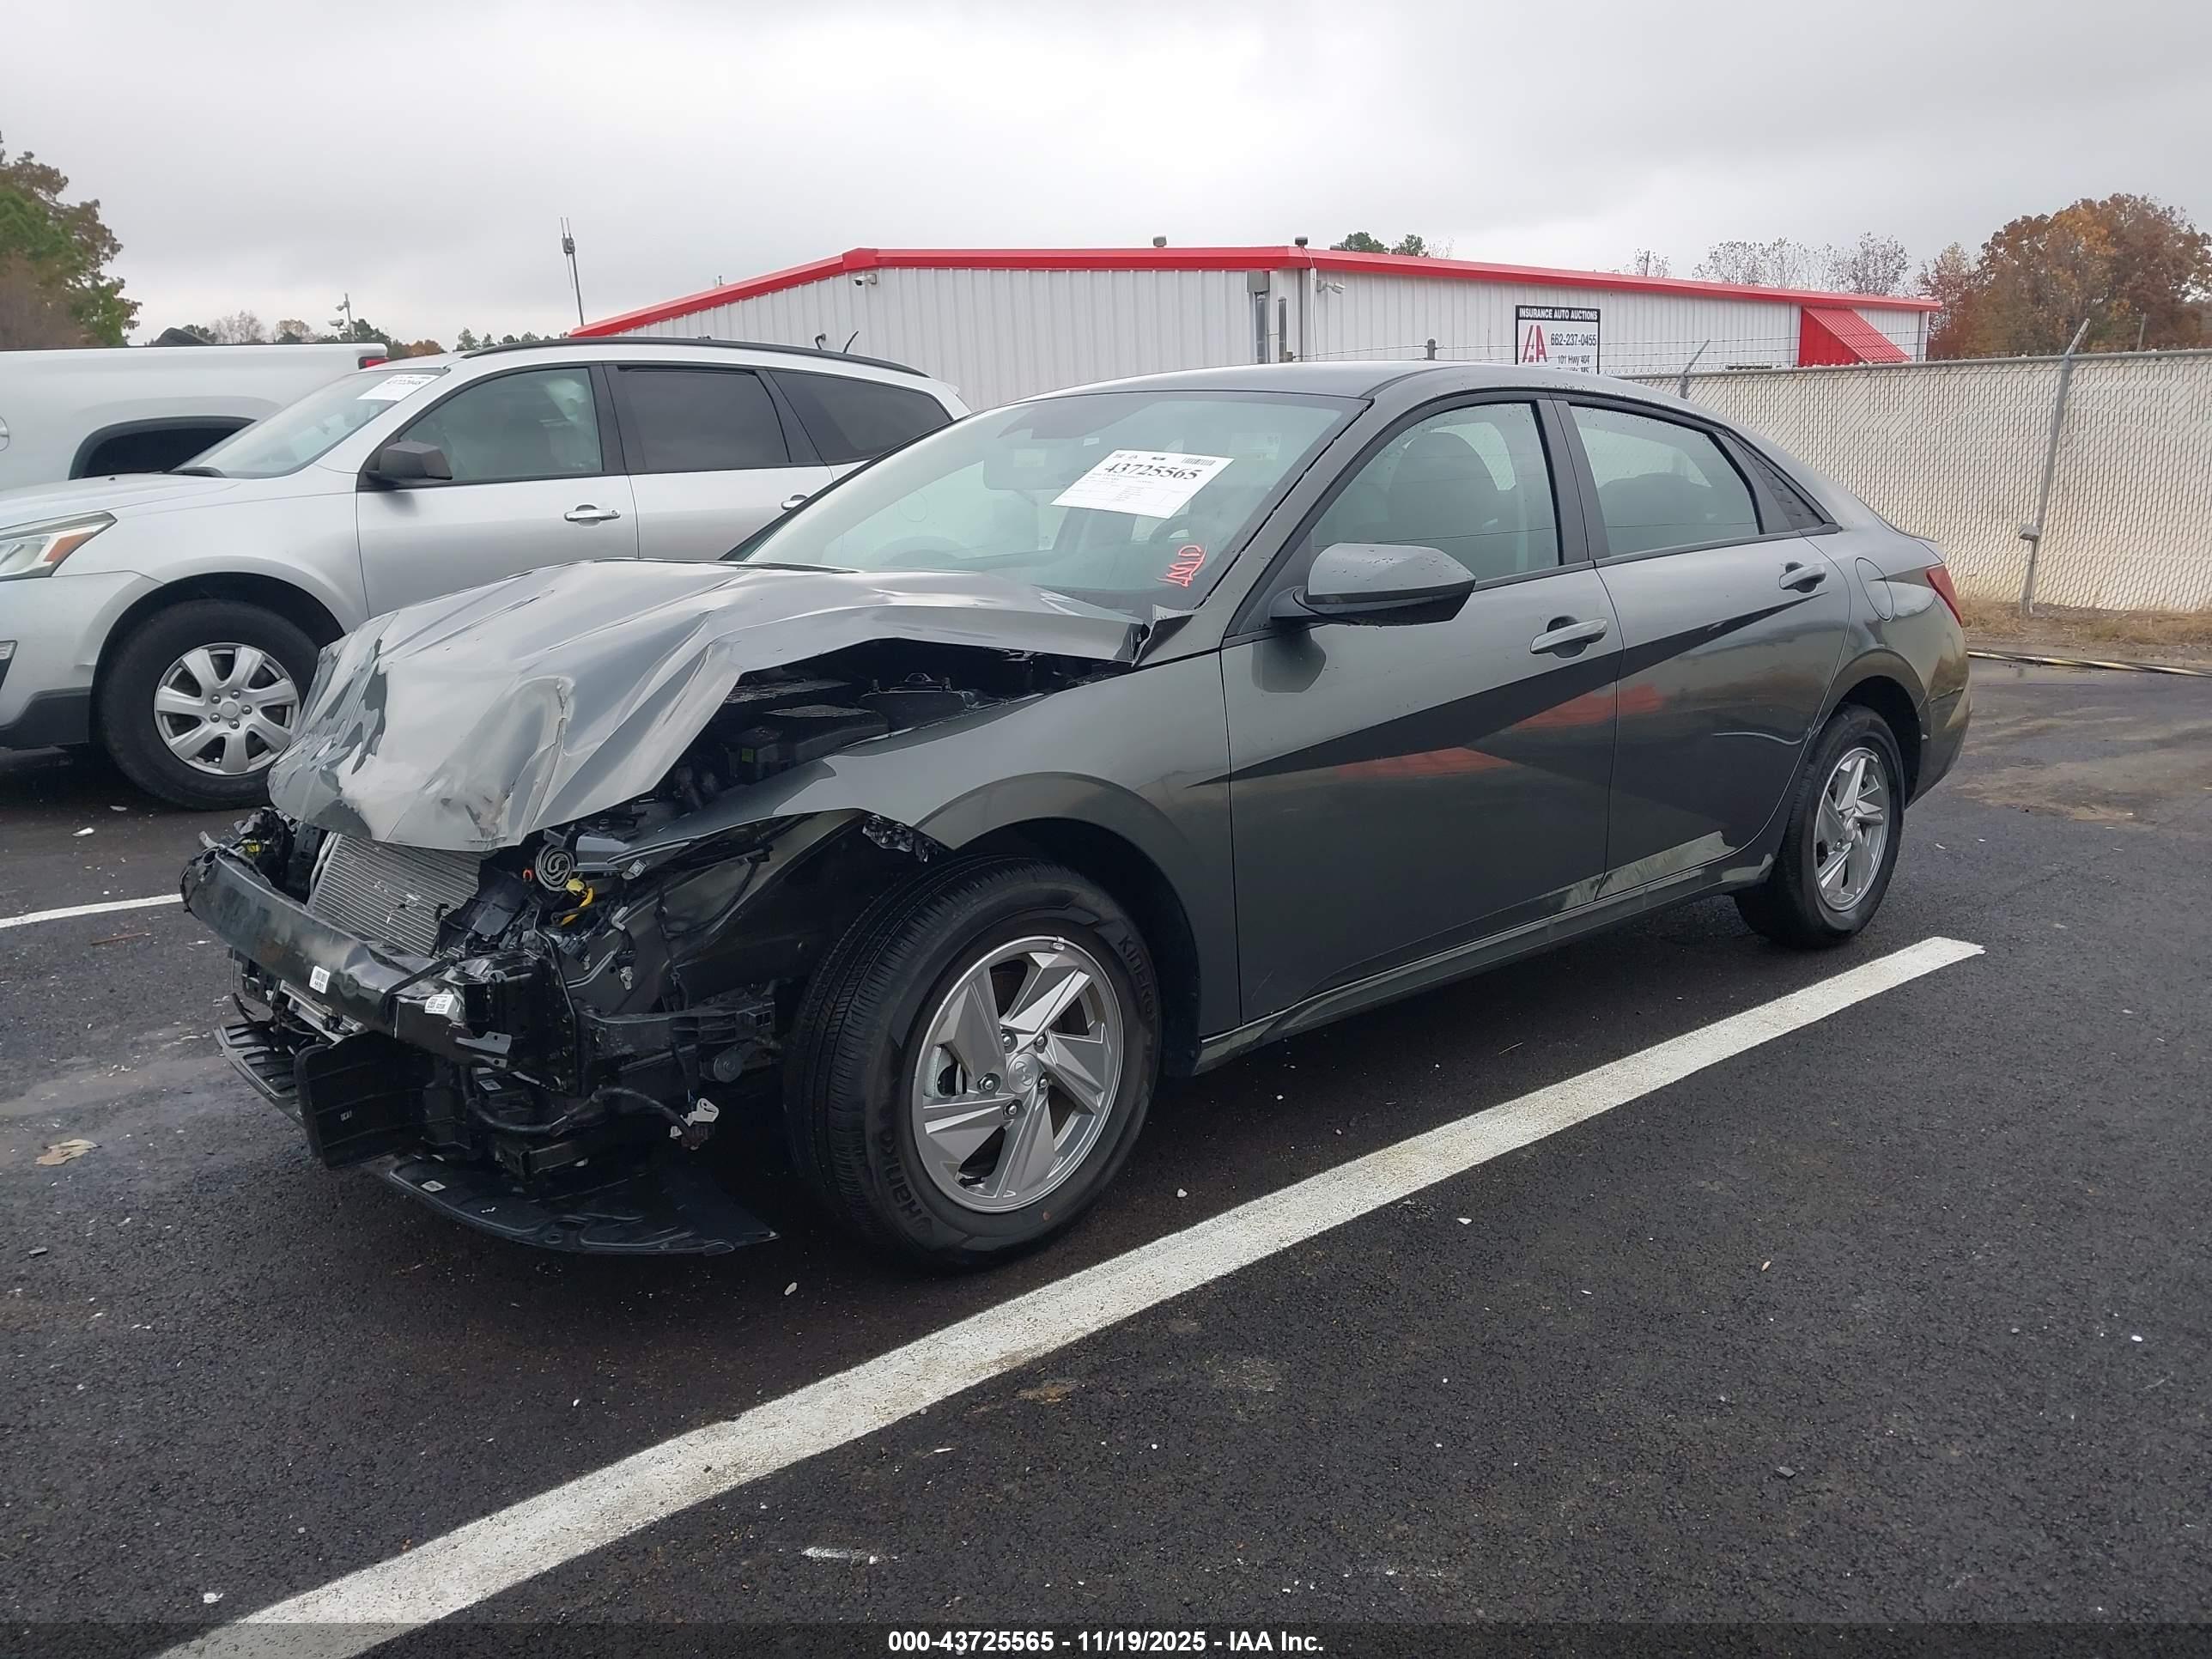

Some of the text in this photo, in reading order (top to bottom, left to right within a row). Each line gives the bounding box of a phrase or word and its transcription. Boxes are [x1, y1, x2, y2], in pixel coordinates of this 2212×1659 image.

[1519, 307, 1598, 321] INSURANCE AUTO AUCTIONS
[1550, 333, 1597, 346] 662-237-0455
[1568, 354, 1580, 367] Hwy
[1104, 462, 1203, 480] 43725565
